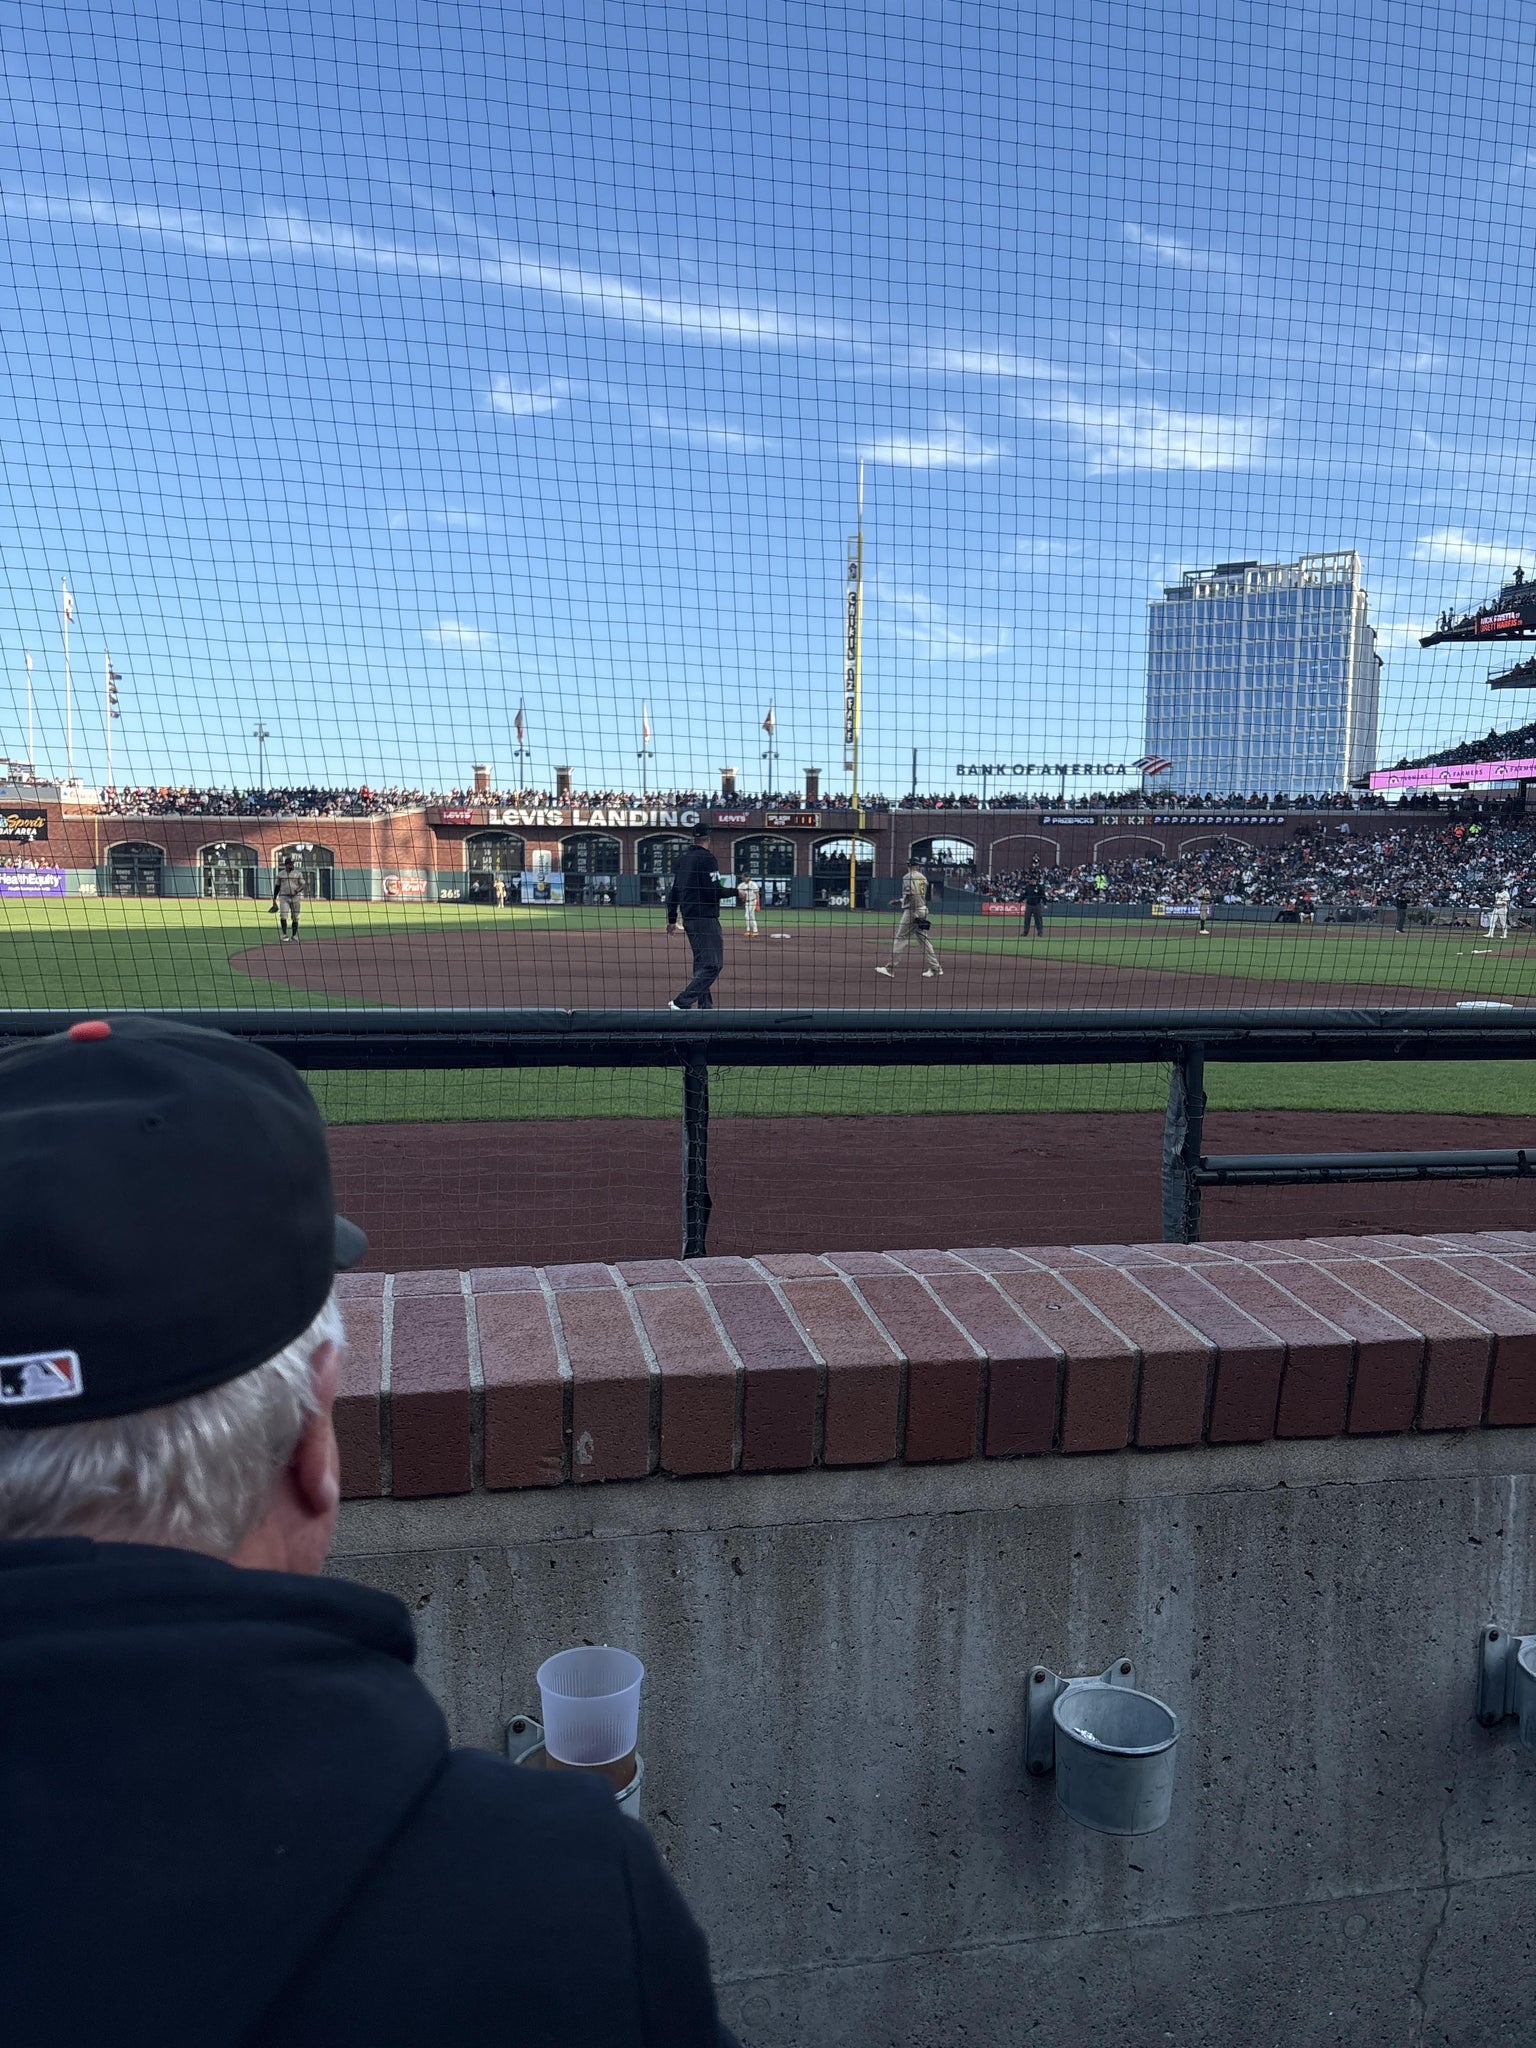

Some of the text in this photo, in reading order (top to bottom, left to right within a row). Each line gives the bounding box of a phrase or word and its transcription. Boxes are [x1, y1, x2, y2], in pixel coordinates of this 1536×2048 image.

[956, 763, 1127, 776] BANK OF AMERICA
[1453, 769, 1483, 777] FARMERS
[1510, 764, 1536, 772] FARME
[6, 814, 45, 829] Sports
[572, 809, 700, 827] LANDING
[0, 873, 59, 887] HealthEquity
[440, 889, 460, 899] 365
[828, 896, 850, 906] 309
